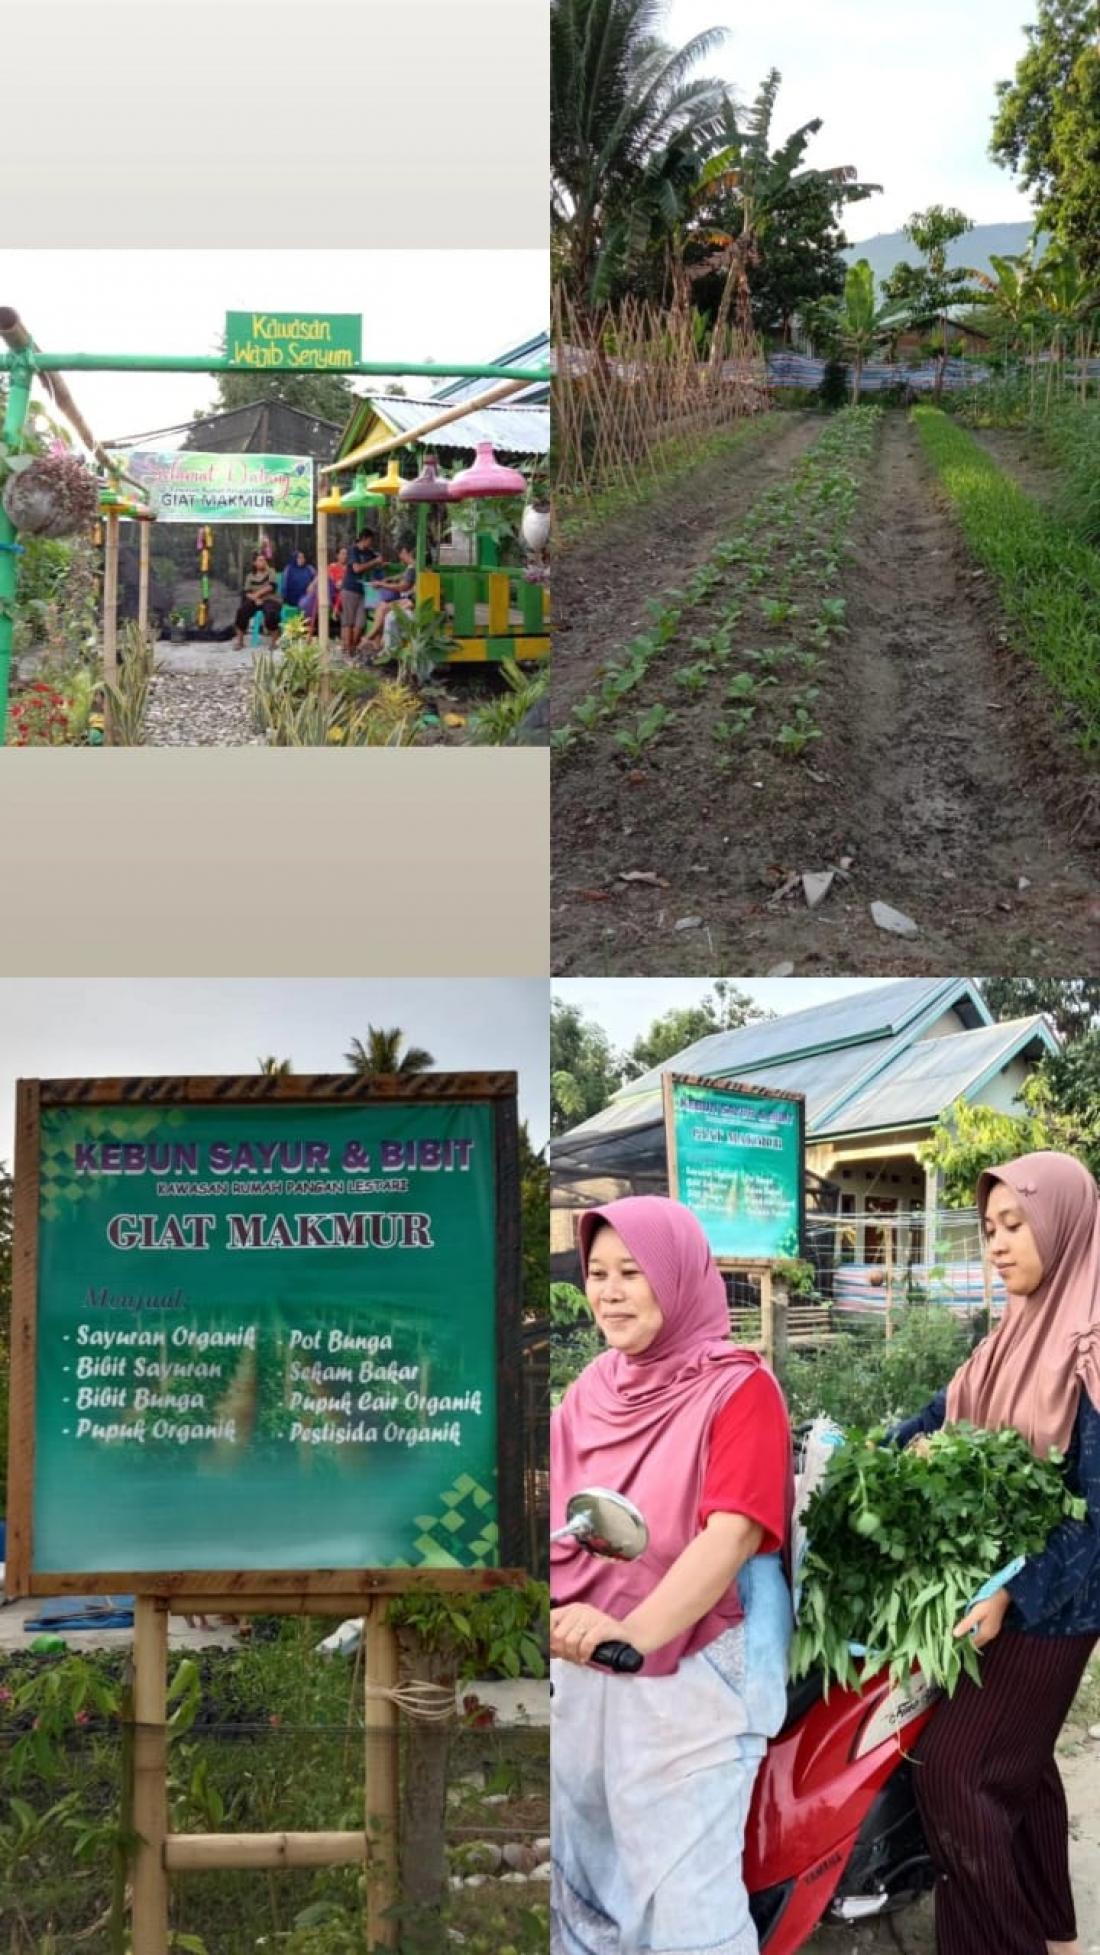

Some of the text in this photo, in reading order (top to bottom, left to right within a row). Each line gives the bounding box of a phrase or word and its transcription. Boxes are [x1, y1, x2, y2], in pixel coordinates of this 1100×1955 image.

[252, 313, 331, 340] Kawasan
[234, 341, 354, 369] Wajib Senyum
[161, 493, 275, 509] GIAT MAKMUR
[74, 1136, 474, 1175] KEBUN SAYUR & BIBIT
[156, 1178, 408, 1197] KAWASAN RUMAH PANGAN LESTARI
[107, 1211, 435, 1250] GIAT MAKMUR
[76, 1324, 257, 1351] Sayuran Organik
[289, 1329, 393, 1355] Pot Bunga
[76, 1355, 222, 1382] Bibit Sayuran
[289, 1360, 419, 1385] Sekam Bakar
[76, 1386, 204, 1413] Bibit Bunga
[289, 1390, 482, 1416] Pupuk Cair Organik
[75, 1418, 236, 1445] Pupuk Organik
[289, 1421, 461, 1447] Pestisida Organik
